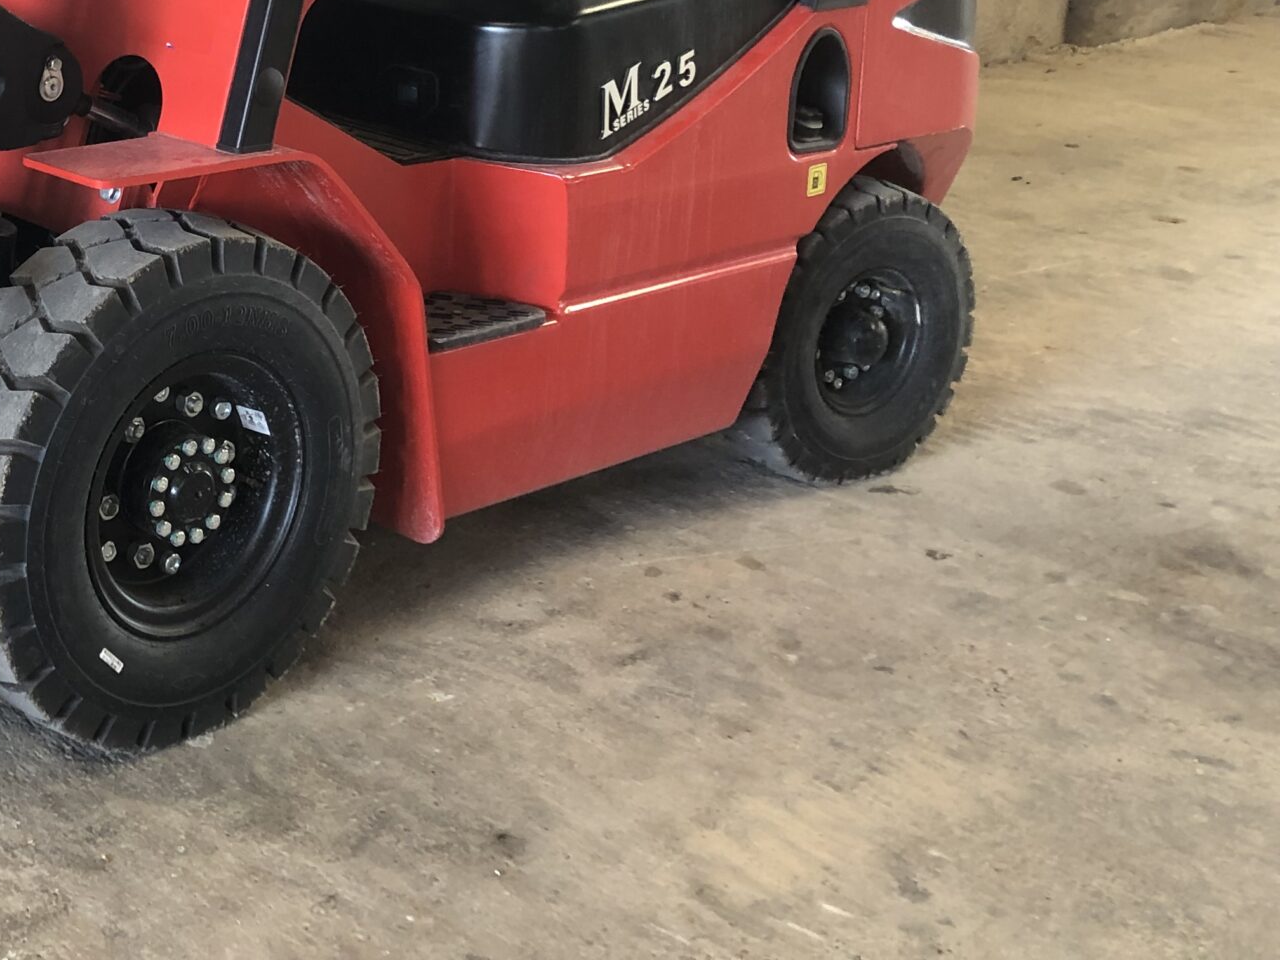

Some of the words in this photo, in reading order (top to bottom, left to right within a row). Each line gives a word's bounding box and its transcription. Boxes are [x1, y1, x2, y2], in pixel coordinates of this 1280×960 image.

[601, 61, 641, 139] M
[653, 49, 696, 101] 25
[613, 99, 650, 131] SERIES
